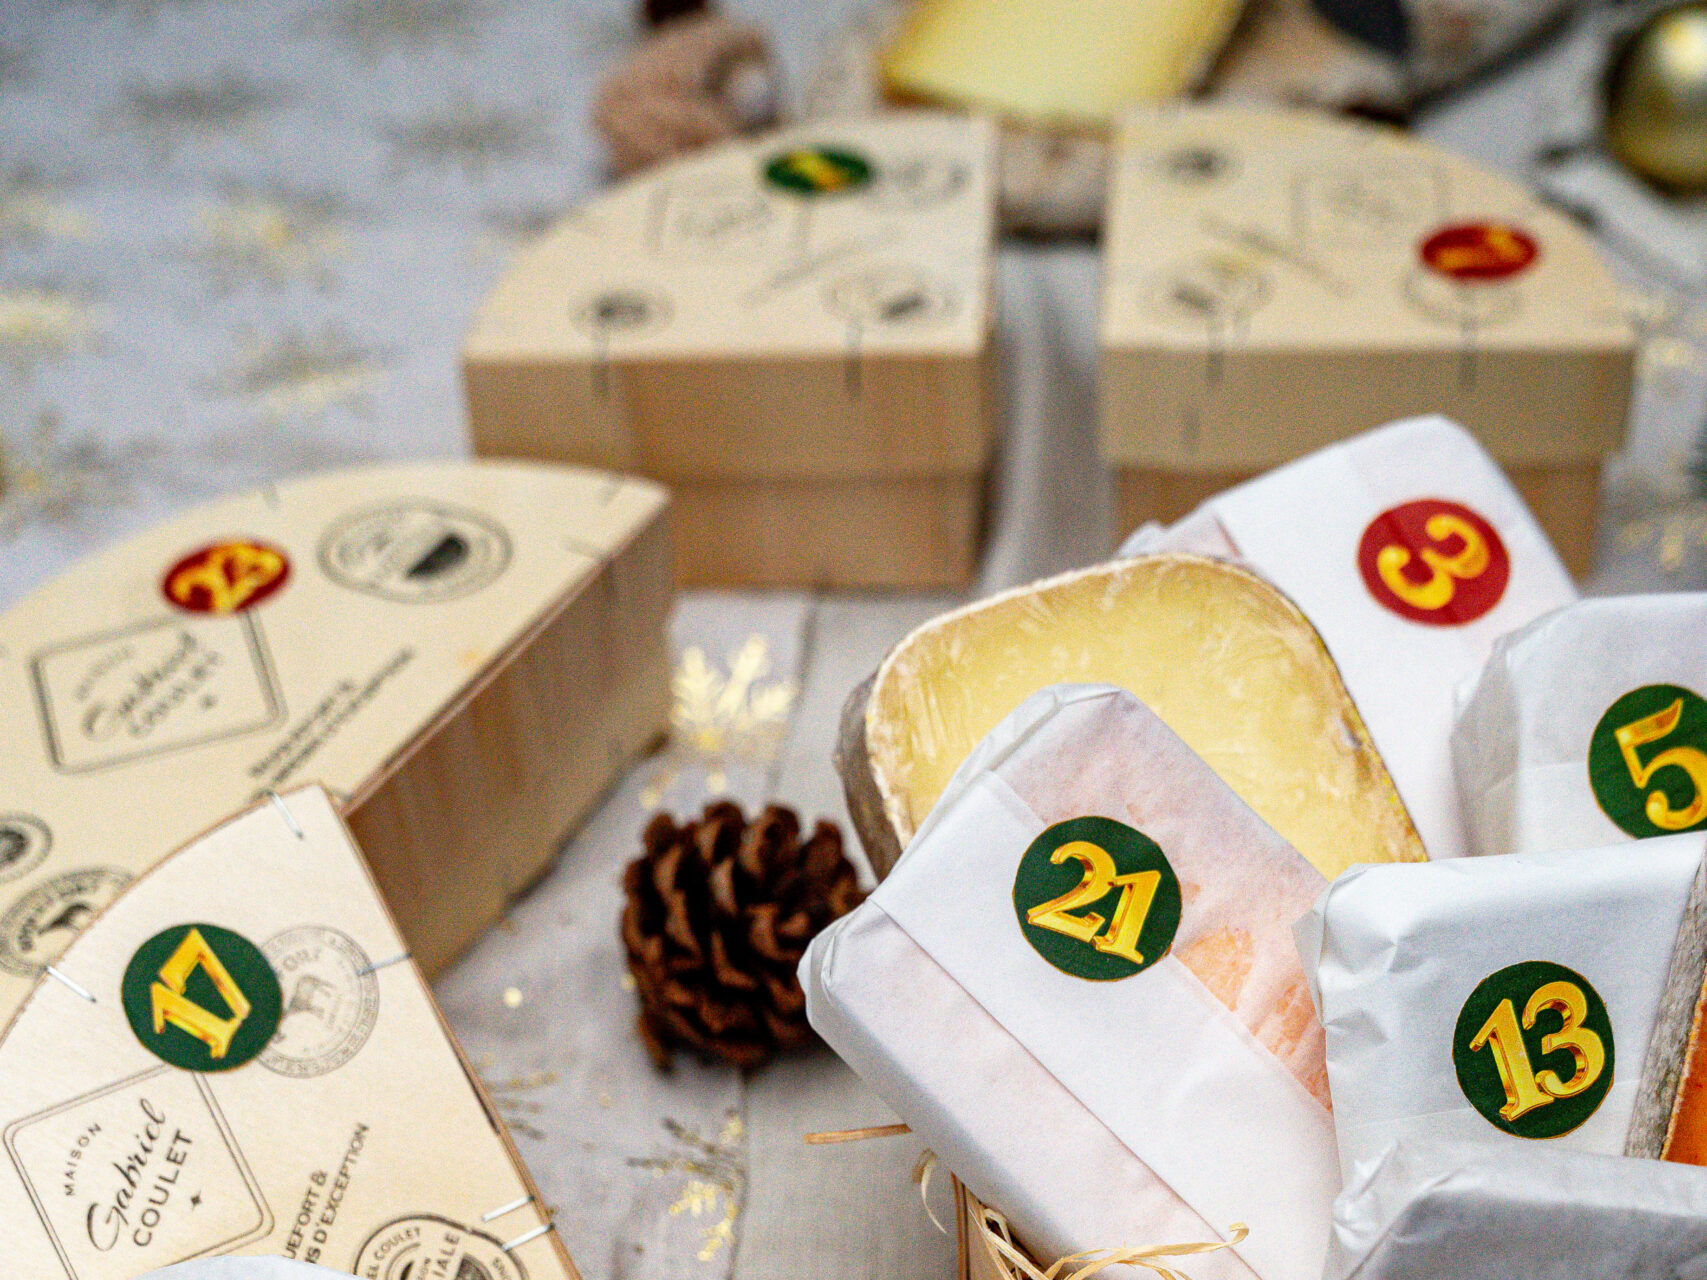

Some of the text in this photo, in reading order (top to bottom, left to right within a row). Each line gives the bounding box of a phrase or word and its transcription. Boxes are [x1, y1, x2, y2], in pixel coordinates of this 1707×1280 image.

[1376, 513, 1491, 611] 3
[1614, 697, 1707, 831] 5
[1025, 840, 1162, 965] 21
[150, 927, 252, 1060] 17
[1469, 980, 1606, 1123] 13
[63, 1122, 103, 1197] MAISON
[86, 1097, 167, 1252] Gabriel
[132, 1127, 194, 1247] COULET
[283, 1169, 329, 1260] UEFORT &
[312, 1122, 370, 1245] D'EXCEPTION
